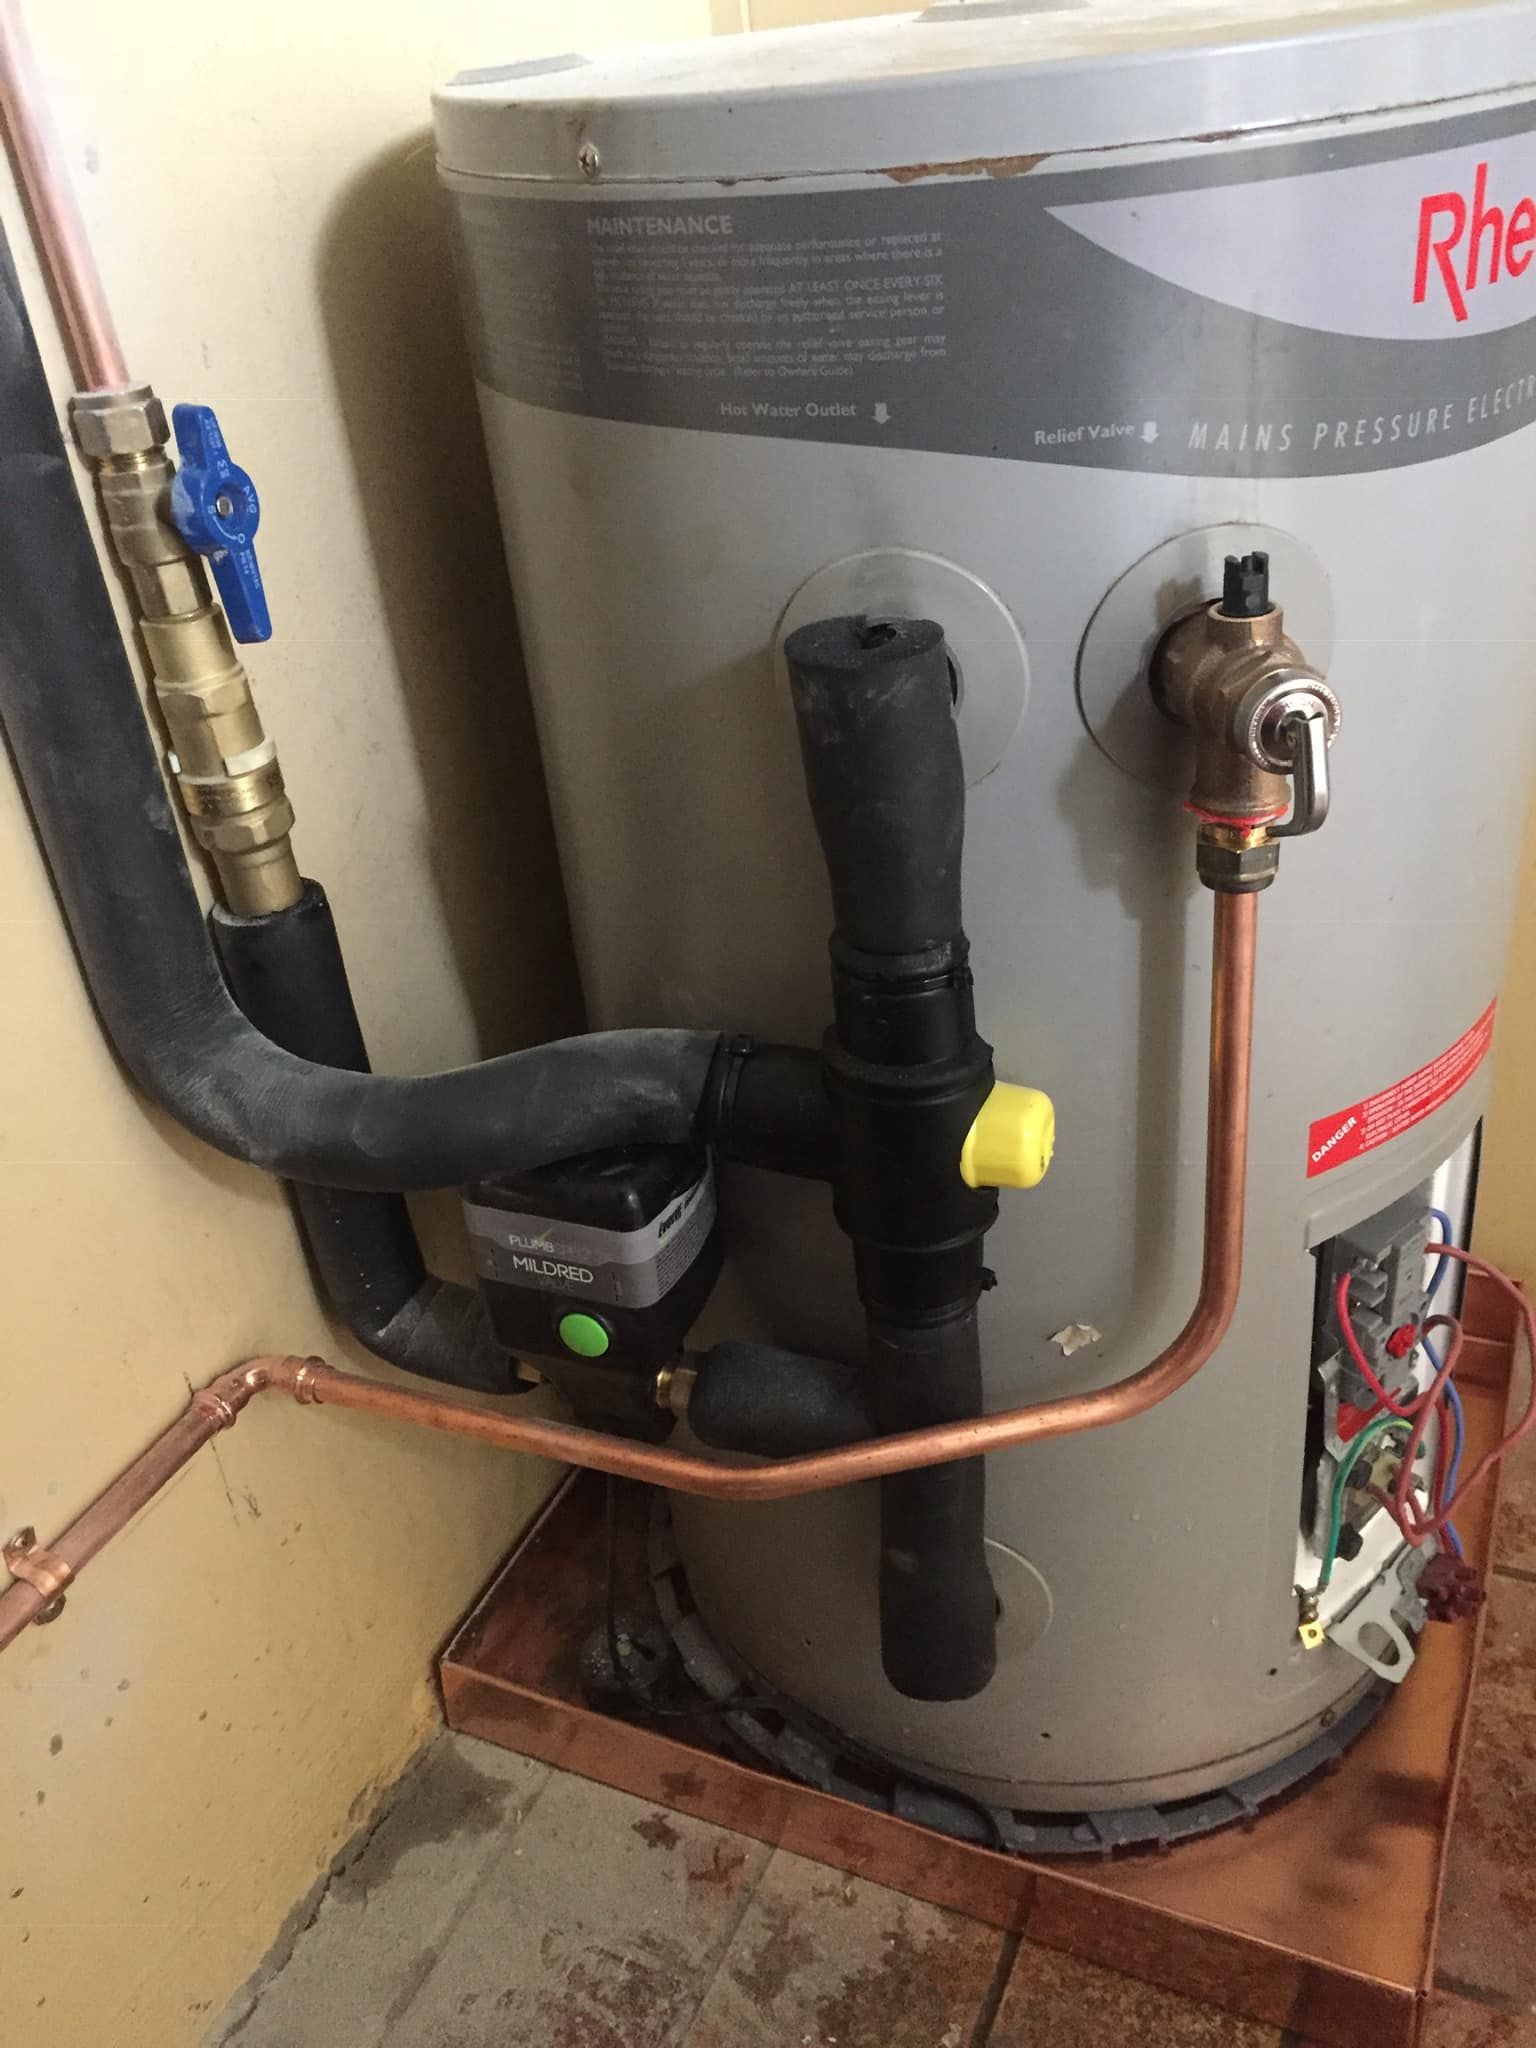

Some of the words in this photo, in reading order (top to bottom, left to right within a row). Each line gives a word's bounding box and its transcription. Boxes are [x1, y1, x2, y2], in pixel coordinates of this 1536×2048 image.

[586, 215, 733, 235] MAINTENANCE
[807, 280, 839, 292] LEAST
[844, 278, 881, 291] ONCE
[883, 275, 919, 289] EVERY
[924, 273, 943, 286] SIX
[890, 306, 928, 319] person
[924, 335, 946, 346] may
[720, 402, 748, 416] Hot
[752, 402, 800, 417] Water
[806, 402, 857, 417] Outlet
[1034, 428, 1085, 446] Relief
[1087, 424, 1135, 442] Valve
[1187, 423, 1293, 451] MAINS
[1313, 403, 1454, 450] PRESSURE
[1311, 1116, 1358, 1163] DANGER
[508, 1234, 556, 1254] PLUMB
[512, 1254, 595, 1284] MILDRED
